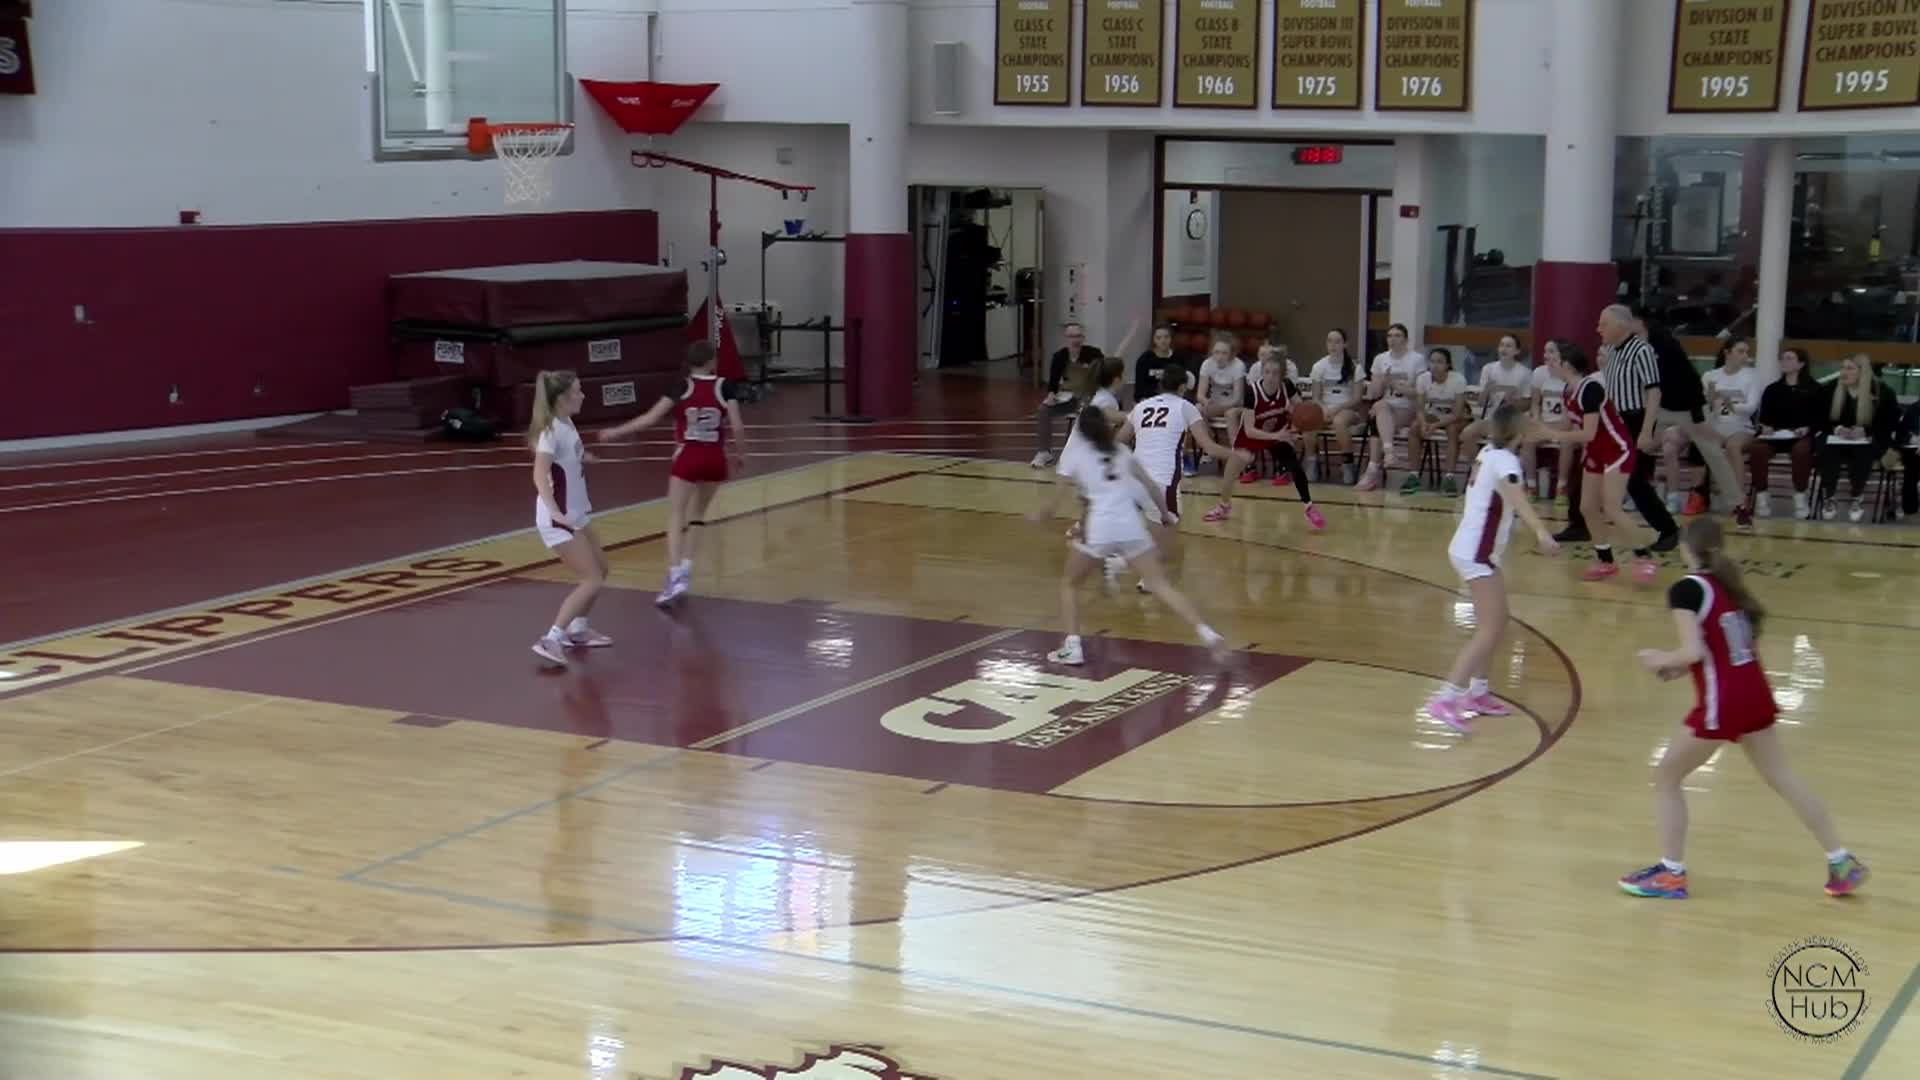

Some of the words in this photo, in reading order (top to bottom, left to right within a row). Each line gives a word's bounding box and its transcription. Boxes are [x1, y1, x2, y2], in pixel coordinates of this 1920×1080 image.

[1689, 8, 1757, 25] DIVISION
[1762, 6, 1773, 22] II
[1821, 0, 1897, 20] DIVISION
[1013, 18, 1044, 31] CLASS
[1046, 18, 1053, 31] C
[1102, 18, 1134, 31] CLASS
[1136, 18, 1143, 31] C
[1195, 18, 1229, 31] CLASS
[1231, 18, 1239, 31] B
[1283, 16, 1337, 30] DIVISION
[1340, 16, 1353, 30] III
[1387, 16, 1442, 30] DIVISION
[1446, 16, 1460, 30] III
[1818, 24, 1865, 42] SUPER
[1871, 19, 1919, 37] BOWL
[1019, 36, 1047, 49] STATE
[1108, 35, 1136, 49] STATE
[1201, 35, 1232, 49] STATE
[1281, 35, 1316, 49] SUPER
[1320, 35, 1352, 49] BOWL
[1385, 34, 1421, 49] SUPER
[1425, 34, 1459, 49] BOWL
[1709, 29, 1750, 46] STATE
[1002, 53, 1064, 67] CHAMPIONS
[1089, 53, 1154, 67] CHAMPIONS
[1281, 53, 1353, 68] CHAMPIONS
[1385, 53, 1459, 68] CHAMPIONS
[1682, 50, 1773, 67] CHAMPIONS
[1815, 41, 1916, 63] CHAMPIONS
[1183, 54, 1250, 68] CHAMPIONS
[1016, 74, 1049, 93] 1955
[1104, 74, 1139, 93] 1956
[1197, 75, 1234, 95] 1966
[1297, 76, 1336, 96] 1975
[1401, 76, 1442, 96] 1976
[1700, 75, 1750, 98] 1995
[1834, 69, 1889, 94] 1995
[683, 407, 721, 442] 12
[1141, 406, 1169, 428] 22
[0, 556, 504, 683] CLIPPERS
